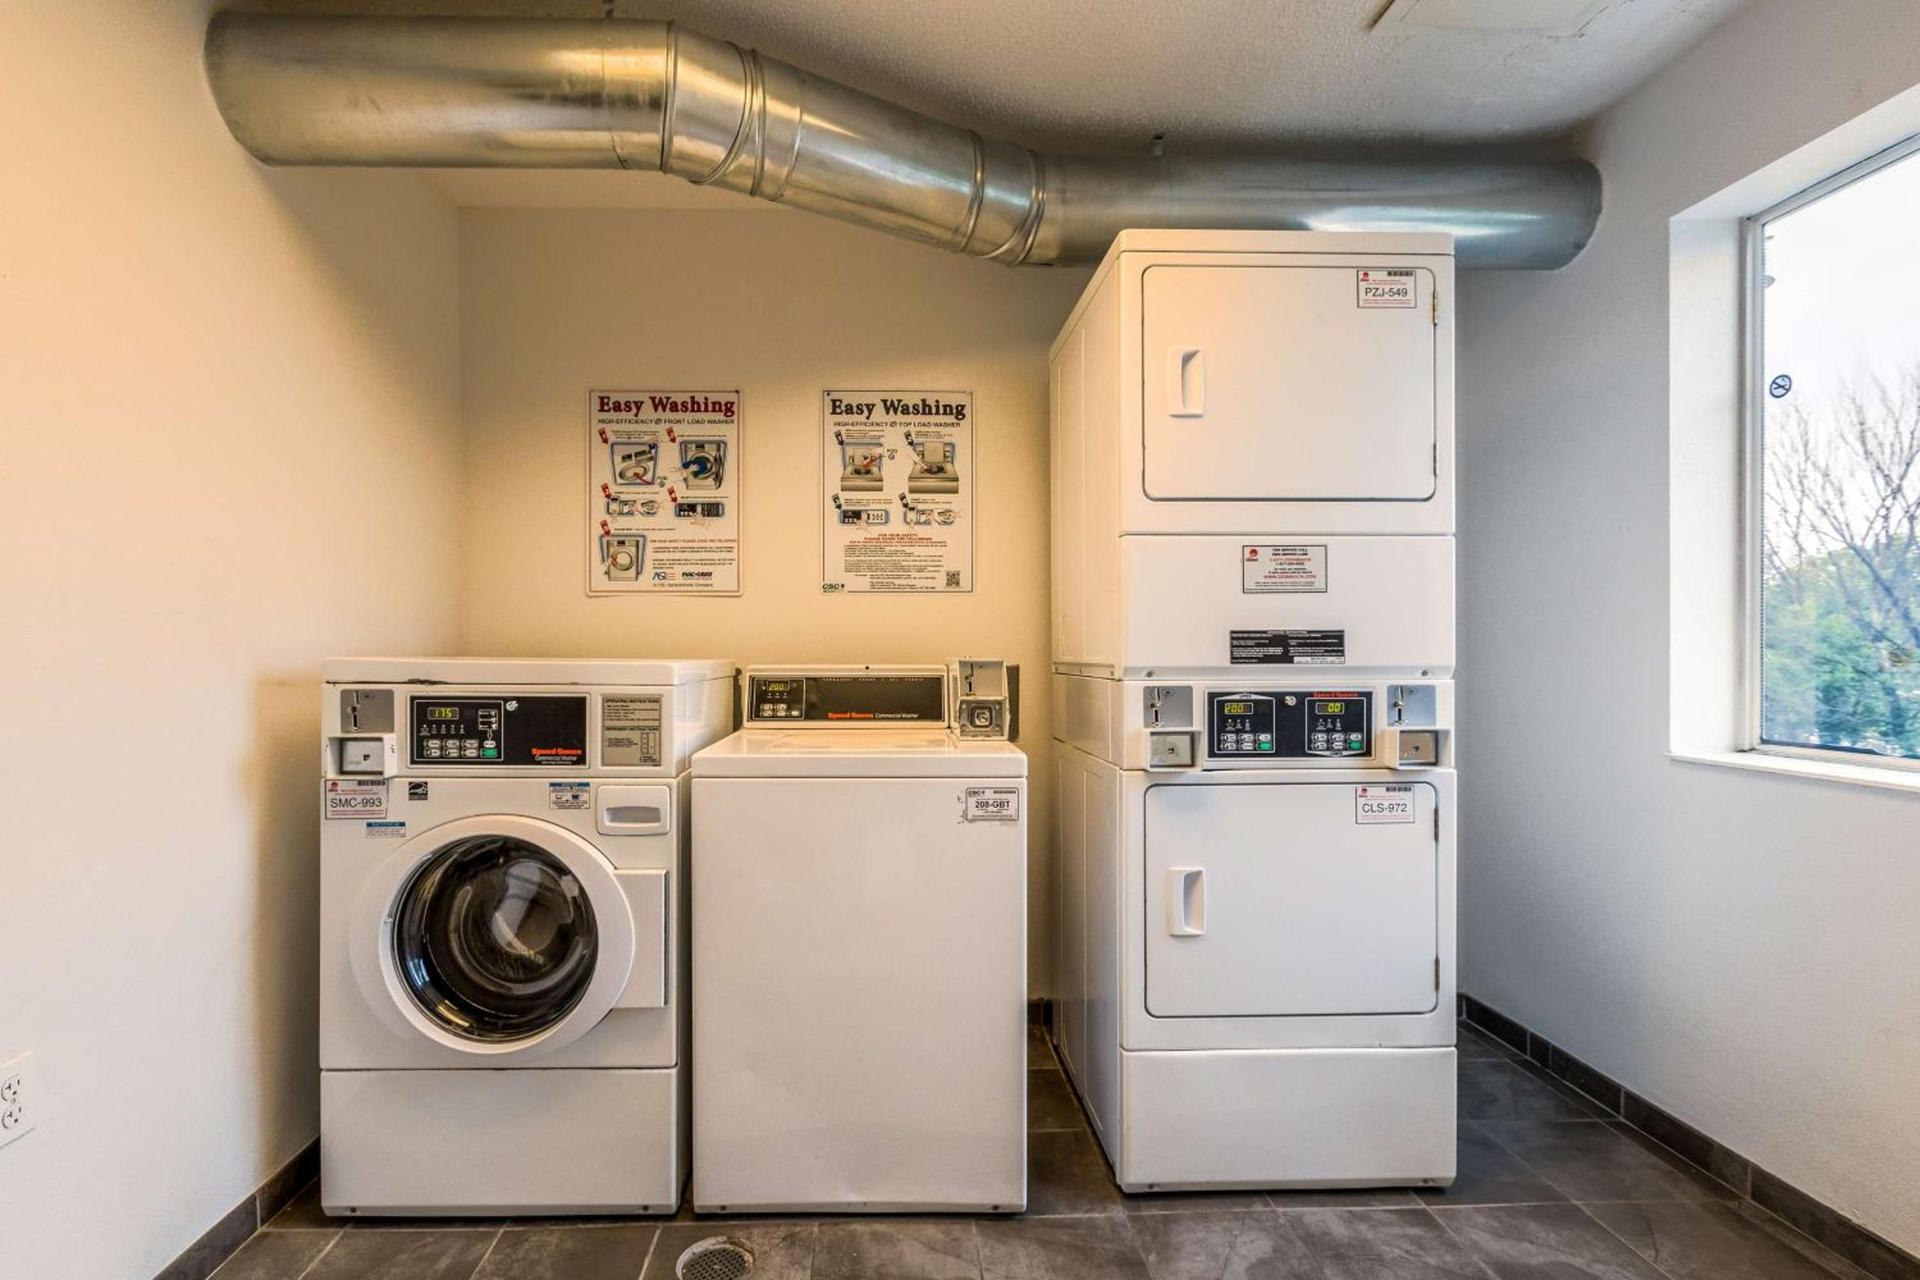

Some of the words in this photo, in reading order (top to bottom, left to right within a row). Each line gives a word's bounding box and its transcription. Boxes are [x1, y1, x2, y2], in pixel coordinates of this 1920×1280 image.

[1364, 287, 1408, 298] PZJ-549
[597, 395, 645, 418] Easy
[649, 395, 736, 418] Washing
[830, 398, 876, 420] Easy
[880, 398, 967, 421] Washing
[531, 748, 556, 756] Speed
[557, 748, 582, 756] Queen
[330, 797, 383, 809] SMC-993
[975, 800, 1010, 809] 208-GBT
[1361, 803, 1408, 813] CLS-972
